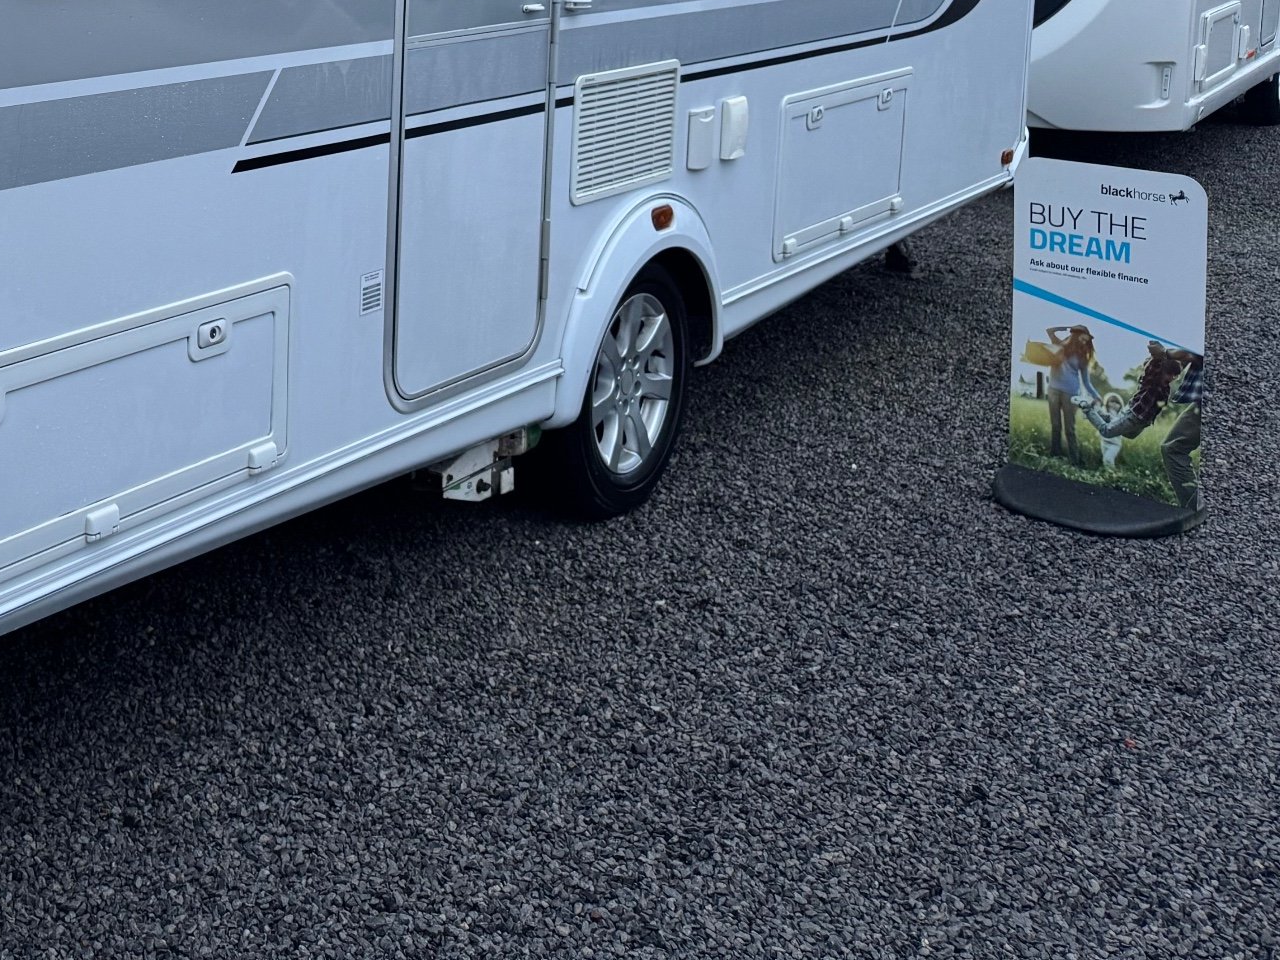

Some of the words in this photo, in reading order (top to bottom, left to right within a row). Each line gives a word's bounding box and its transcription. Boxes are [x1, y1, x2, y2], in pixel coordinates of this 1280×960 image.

[1100, 183, 1166, 203] blackhorse
[1030, 202, 1083, 230] BUY
[1090, 210, 1147, 240] THE
[1030, 227, 1131, 264] DREAM
[1029, 258, 1045, 268] Ask
[1046, 261, 1069, 272] about
[1070, 265, 1084, 274] our
[1086, 267, 1116, 280] flexible
[1117, 272, 1149, 285] finance
